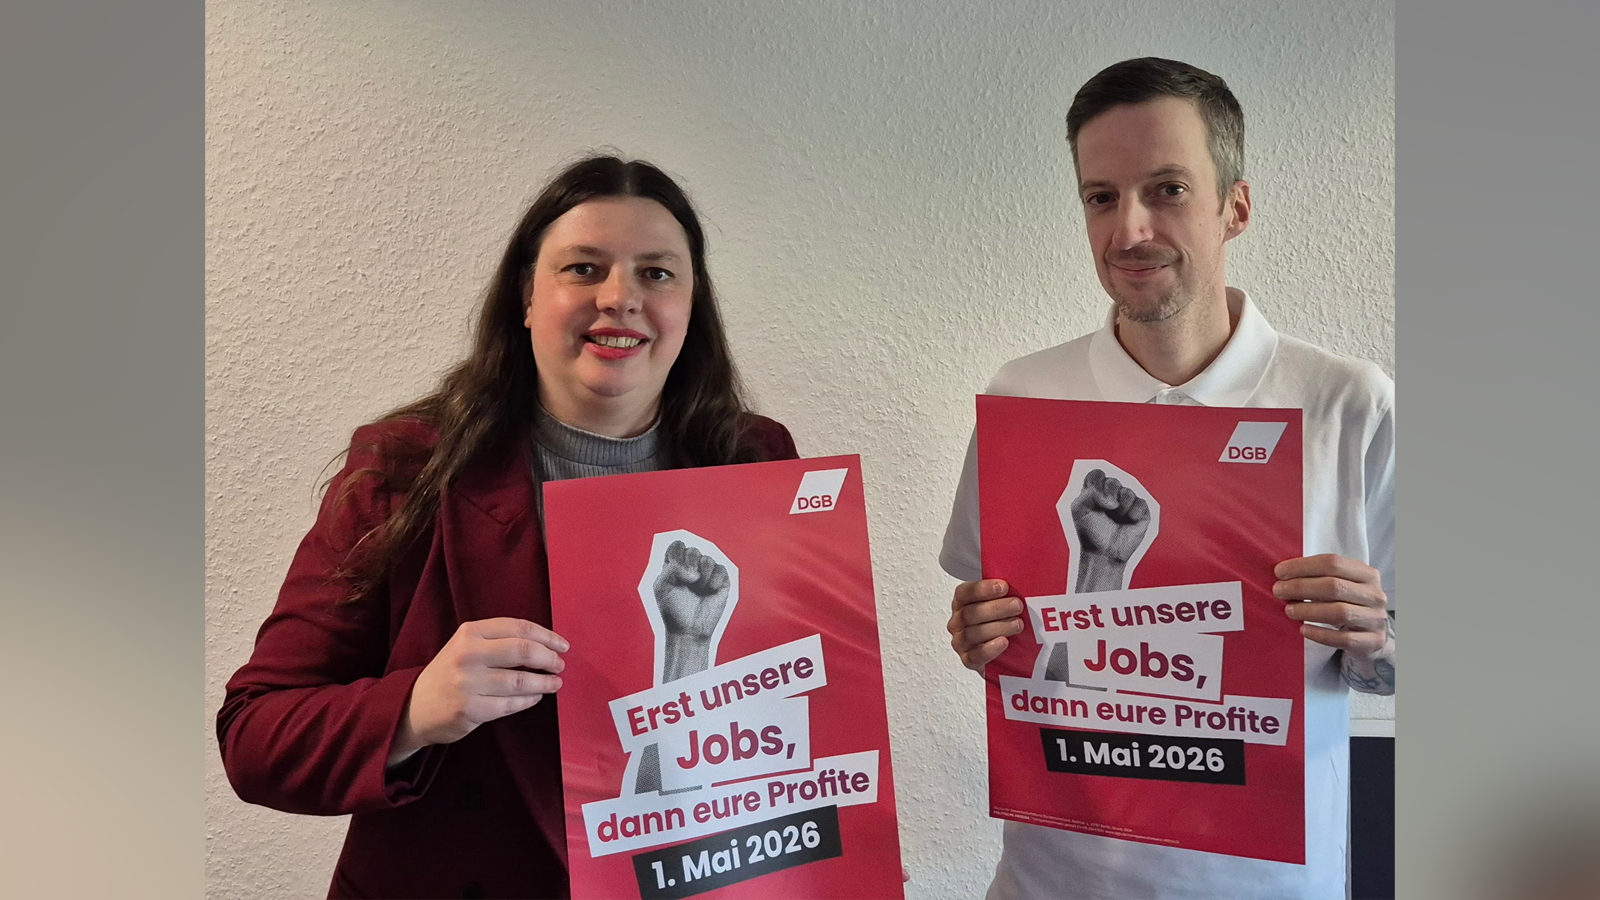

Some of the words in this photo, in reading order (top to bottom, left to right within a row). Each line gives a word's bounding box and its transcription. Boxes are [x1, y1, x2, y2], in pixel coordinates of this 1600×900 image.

[1228, 446, 1267, 460] DGB
[797, 495, 832, 510] DGB
[1041, 603, 1105, 632] Erst
[1111, 596, 1232, 627] unsere
[1083, 640, 1208, 689] Jobs,
[627, 689, 695, 737] Erst
[700, 655, 814, 712] unsere
[1011, 690, 1088, 719] dann
[1096, 704, 1167, 725] eure
[1175, 706, 1280, 735] Profite
[676, 722, 796, 770] Jobs,
[1056, 738, 1077, 762] 1.
[1084, 741, 1141, 767] Mai
[1148, 745, 1225, 772] 2026
[597, 805, 685, 842] dann
[693, 792, 760, 823] eure
[768, 767, 870, 807] Profite
[651, 861, 675, 889] 1.
[683, 839, 740, 883] Mai
[746, 820, 821, 864] 2026
